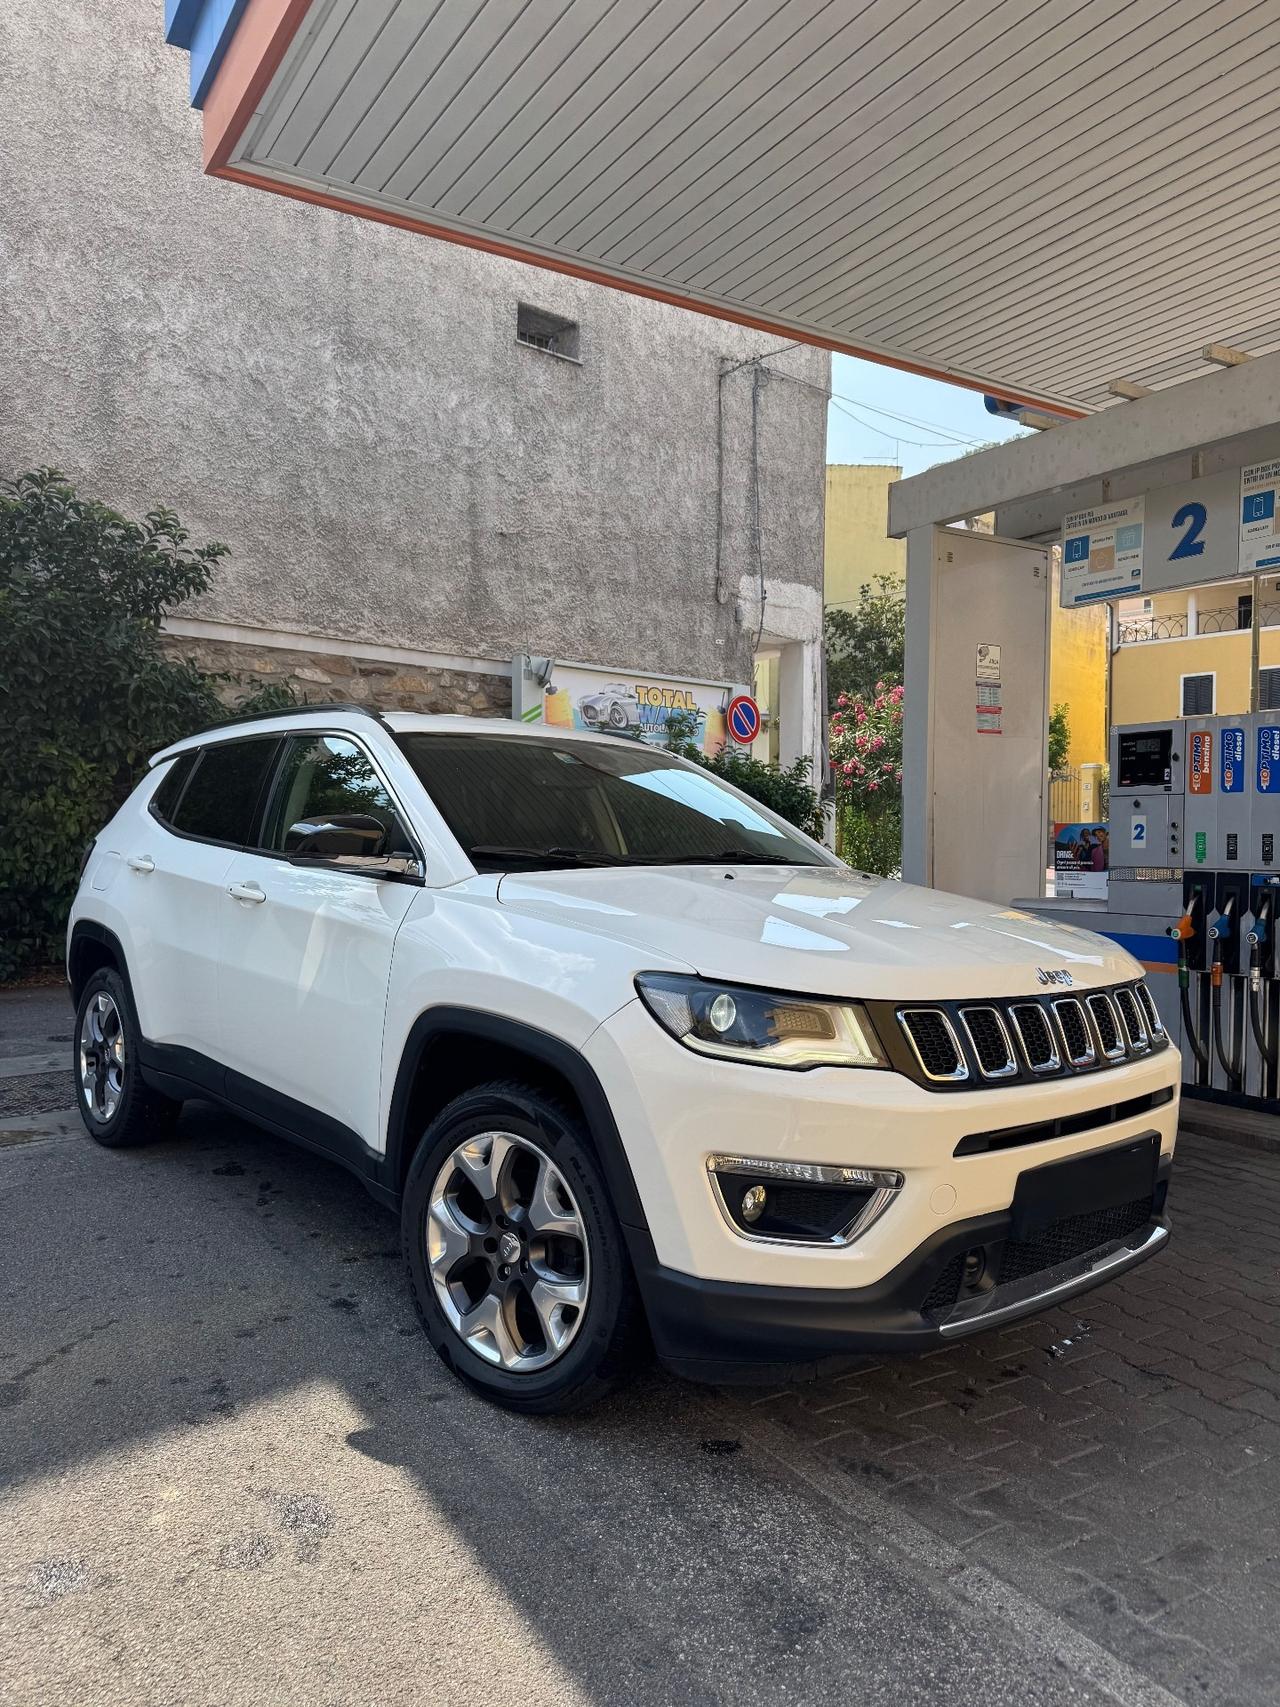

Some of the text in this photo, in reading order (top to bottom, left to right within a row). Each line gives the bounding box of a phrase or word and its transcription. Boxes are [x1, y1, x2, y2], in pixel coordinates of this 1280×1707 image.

[1168, 502, 1207, 560] 2
[635, 685, 697, 711] TOTAL
[1202, 735, 1211, 774] benzina
[1234, 732, 1243, 761] diesel
[1271, 730, 1280, 761] diesel
[1133, 823, 1145, 840] 2
[1034, 967, 1073, 986] Jeep
